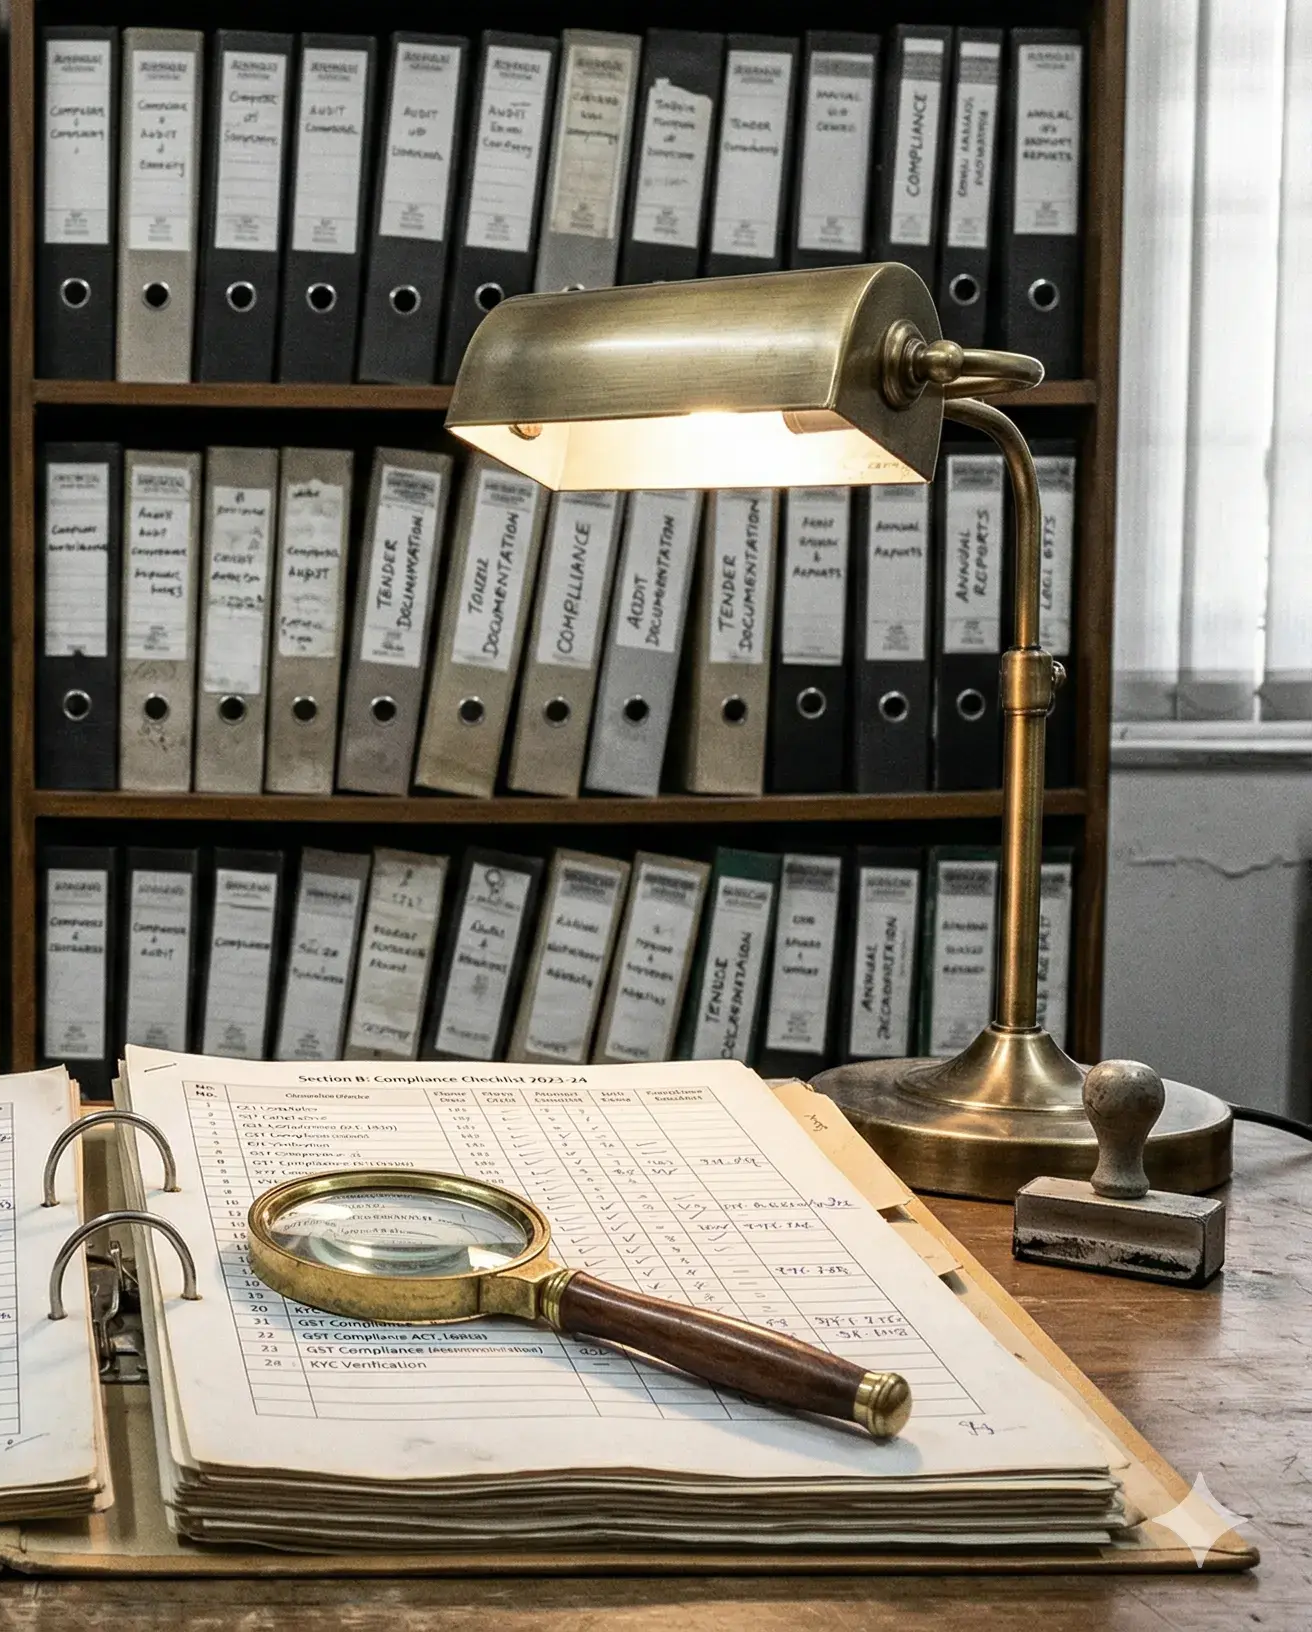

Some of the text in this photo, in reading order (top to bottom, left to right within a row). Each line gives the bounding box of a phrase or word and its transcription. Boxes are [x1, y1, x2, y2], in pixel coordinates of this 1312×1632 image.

[905, 91, 929, 198] COMPLIANCE
[954, 527, 972, 604] ANNUAL
[376, 538, 399, 610] TENDER
[718, 554, 737, 633] TENDER
[298, 1075, 588, 1085] Section B: Compliance Checklist 2023-24
[195, 1091, 218, 1099] No.
[250, 1305, 269, 1313] 20
[298, 1318, 325, 1328] GST
[256, 1331, 276, 1339] 22
[302, 1332, 329, 1341] GST
[261, 1345, 424, 1357] 23 GST Compliance
[310, 1360, 339, 1369] KYC
